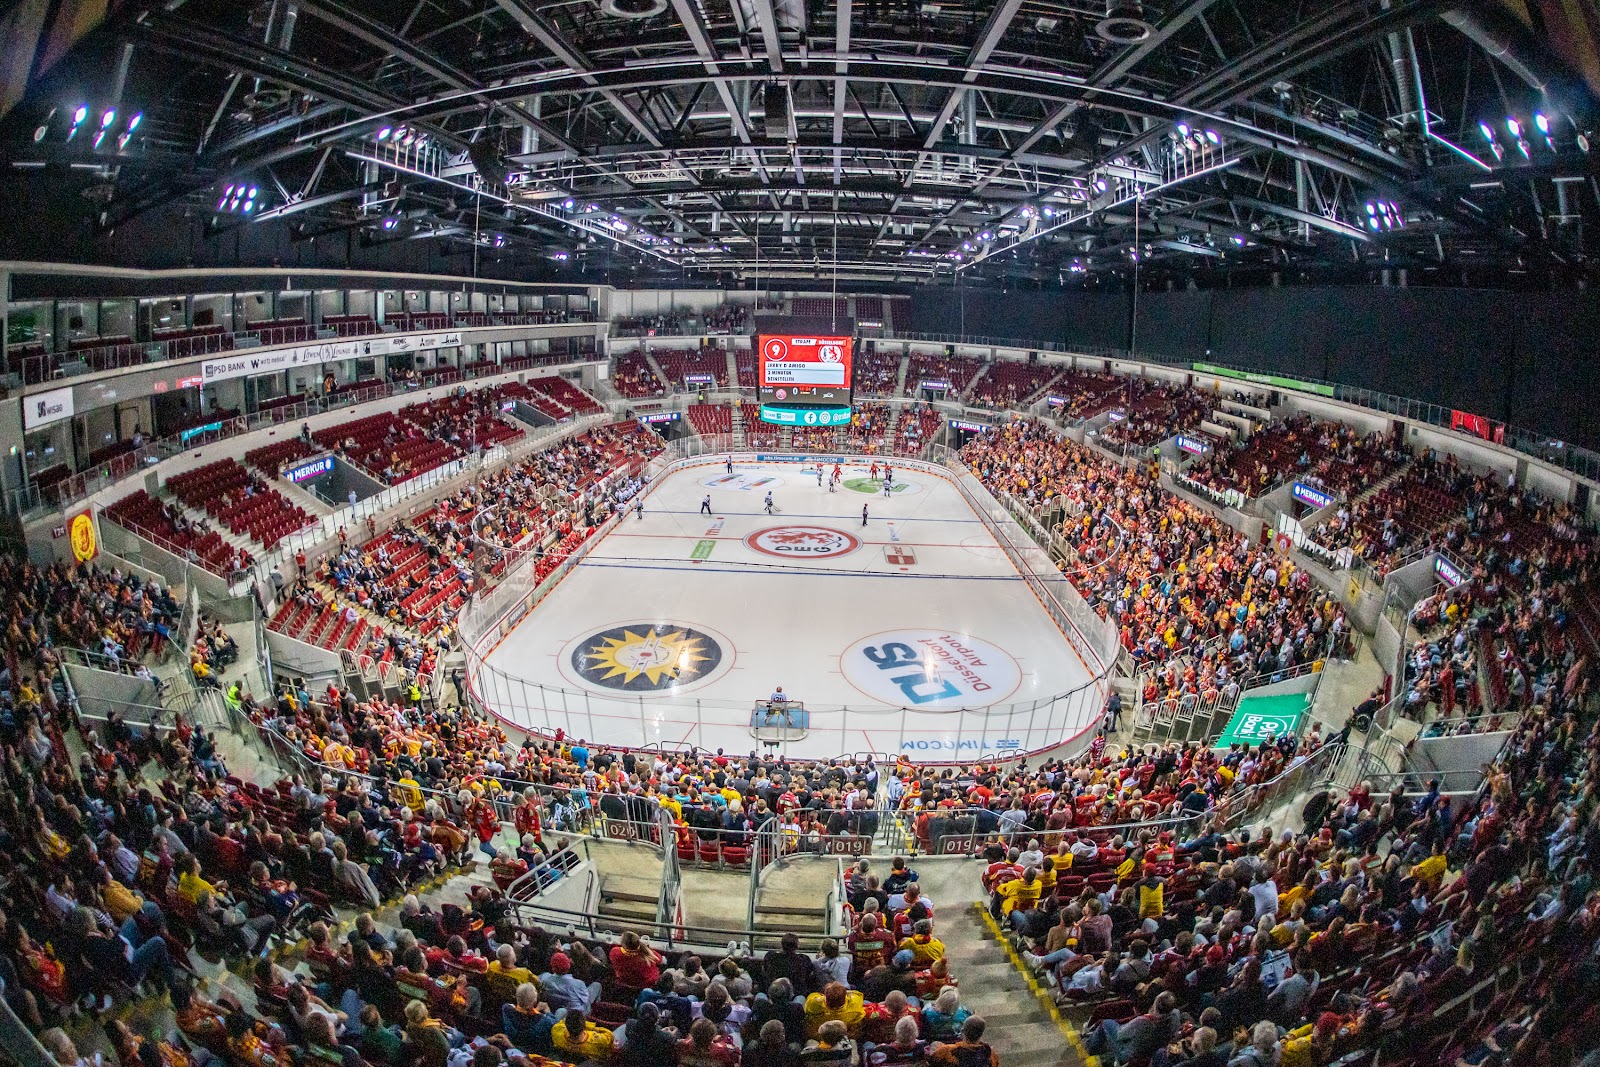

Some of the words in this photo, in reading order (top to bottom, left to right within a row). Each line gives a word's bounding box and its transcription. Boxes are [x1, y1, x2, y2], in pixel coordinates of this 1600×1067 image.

[771, 344, 780, 356] 9
[213, 363, 226, 374] PSD
[227, 362, 246, 372] BANK
[792, 387, 799, 395] 0
[811, 387, 817, 395] 1
[648, 413, 672, 421] MERKUR
[957, 421, 982, 432] MERKUR
[1183, 438, 1202, 453] MERKUR
[294, 461, 325, 480] MERKUR
[1300, 487, 1325, 505] MERKUR
[775, 545, 831, 553] DEG
[939, 635, 988, 667] Airport
[917, 639, 992, 692] Düsseldorf
[901, 740, 991, 750] TIMOCOM
[610, 824, 636, 837] 020
[1137, 826, 1158, 839] 08
[836, 840, 863, 852] 019
[946, 840, 971, 851] 019
